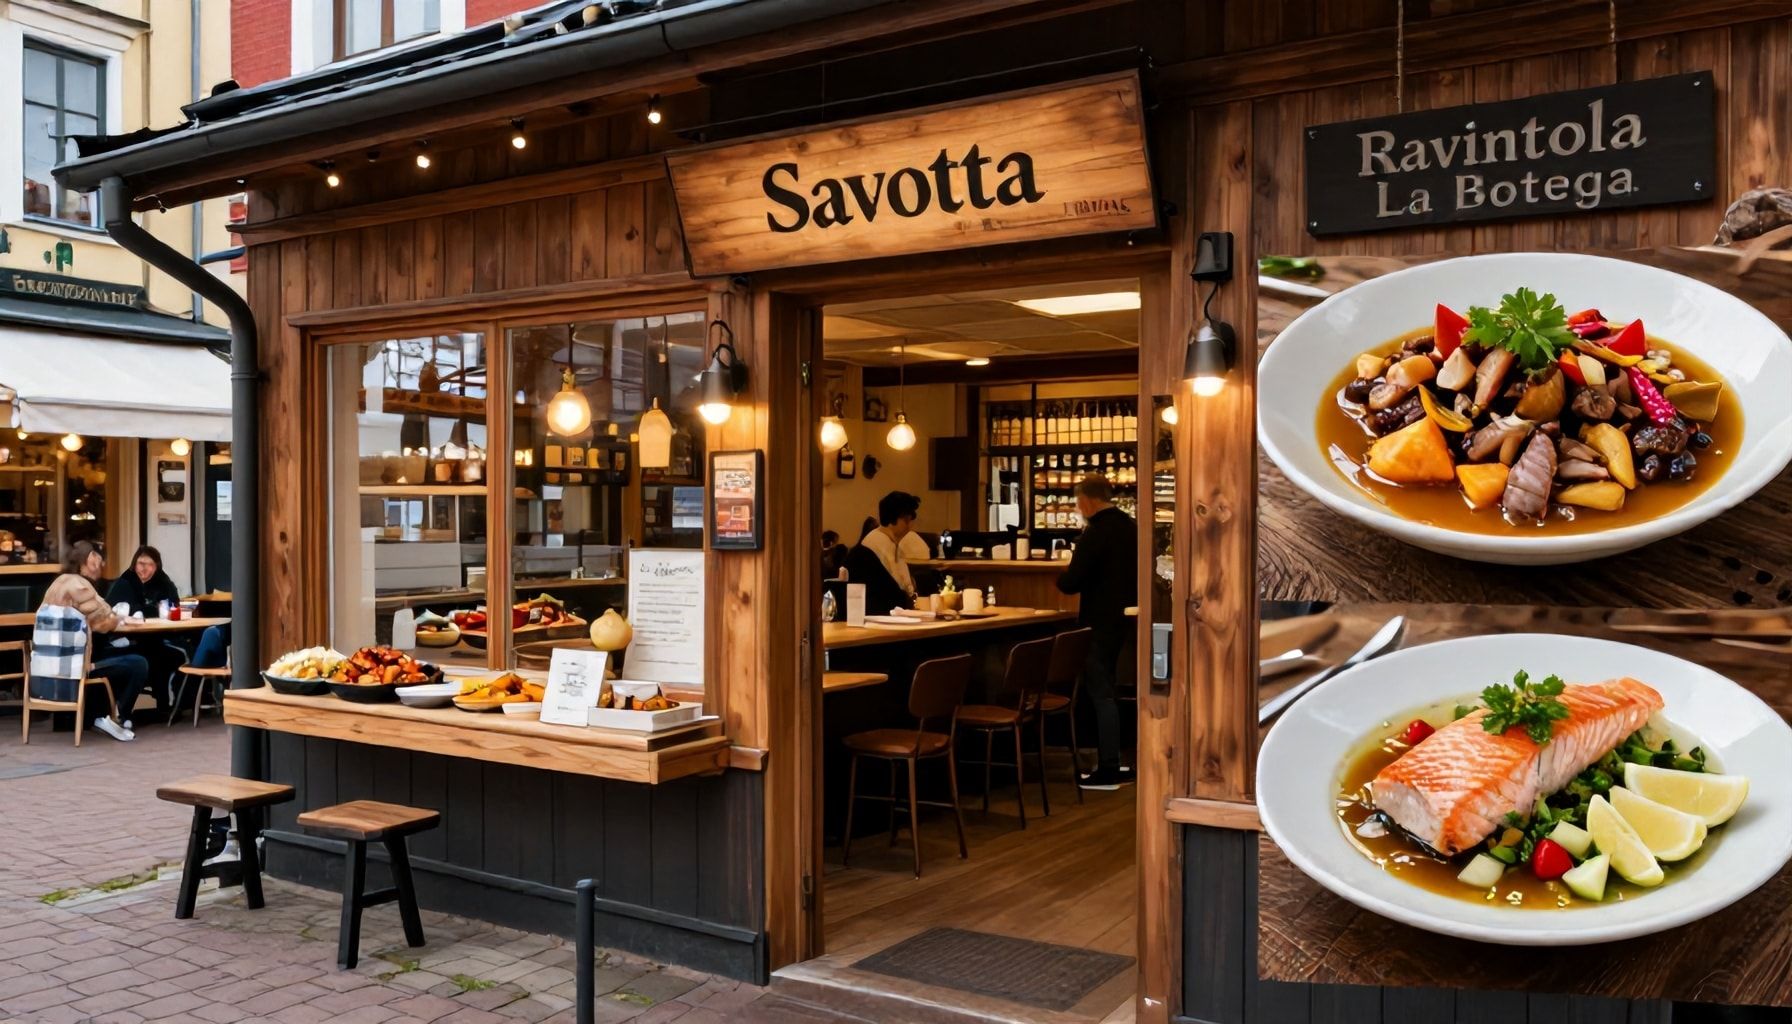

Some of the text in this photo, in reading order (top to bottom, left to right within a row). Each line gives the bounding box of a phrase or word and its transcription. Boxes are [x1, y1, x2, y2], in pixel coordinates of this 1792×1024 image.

[1356, 99, 1647, 178] Ravintola
[761, 143, 1049, 233] Savotta
[1376, 181, 1433, 218] La
